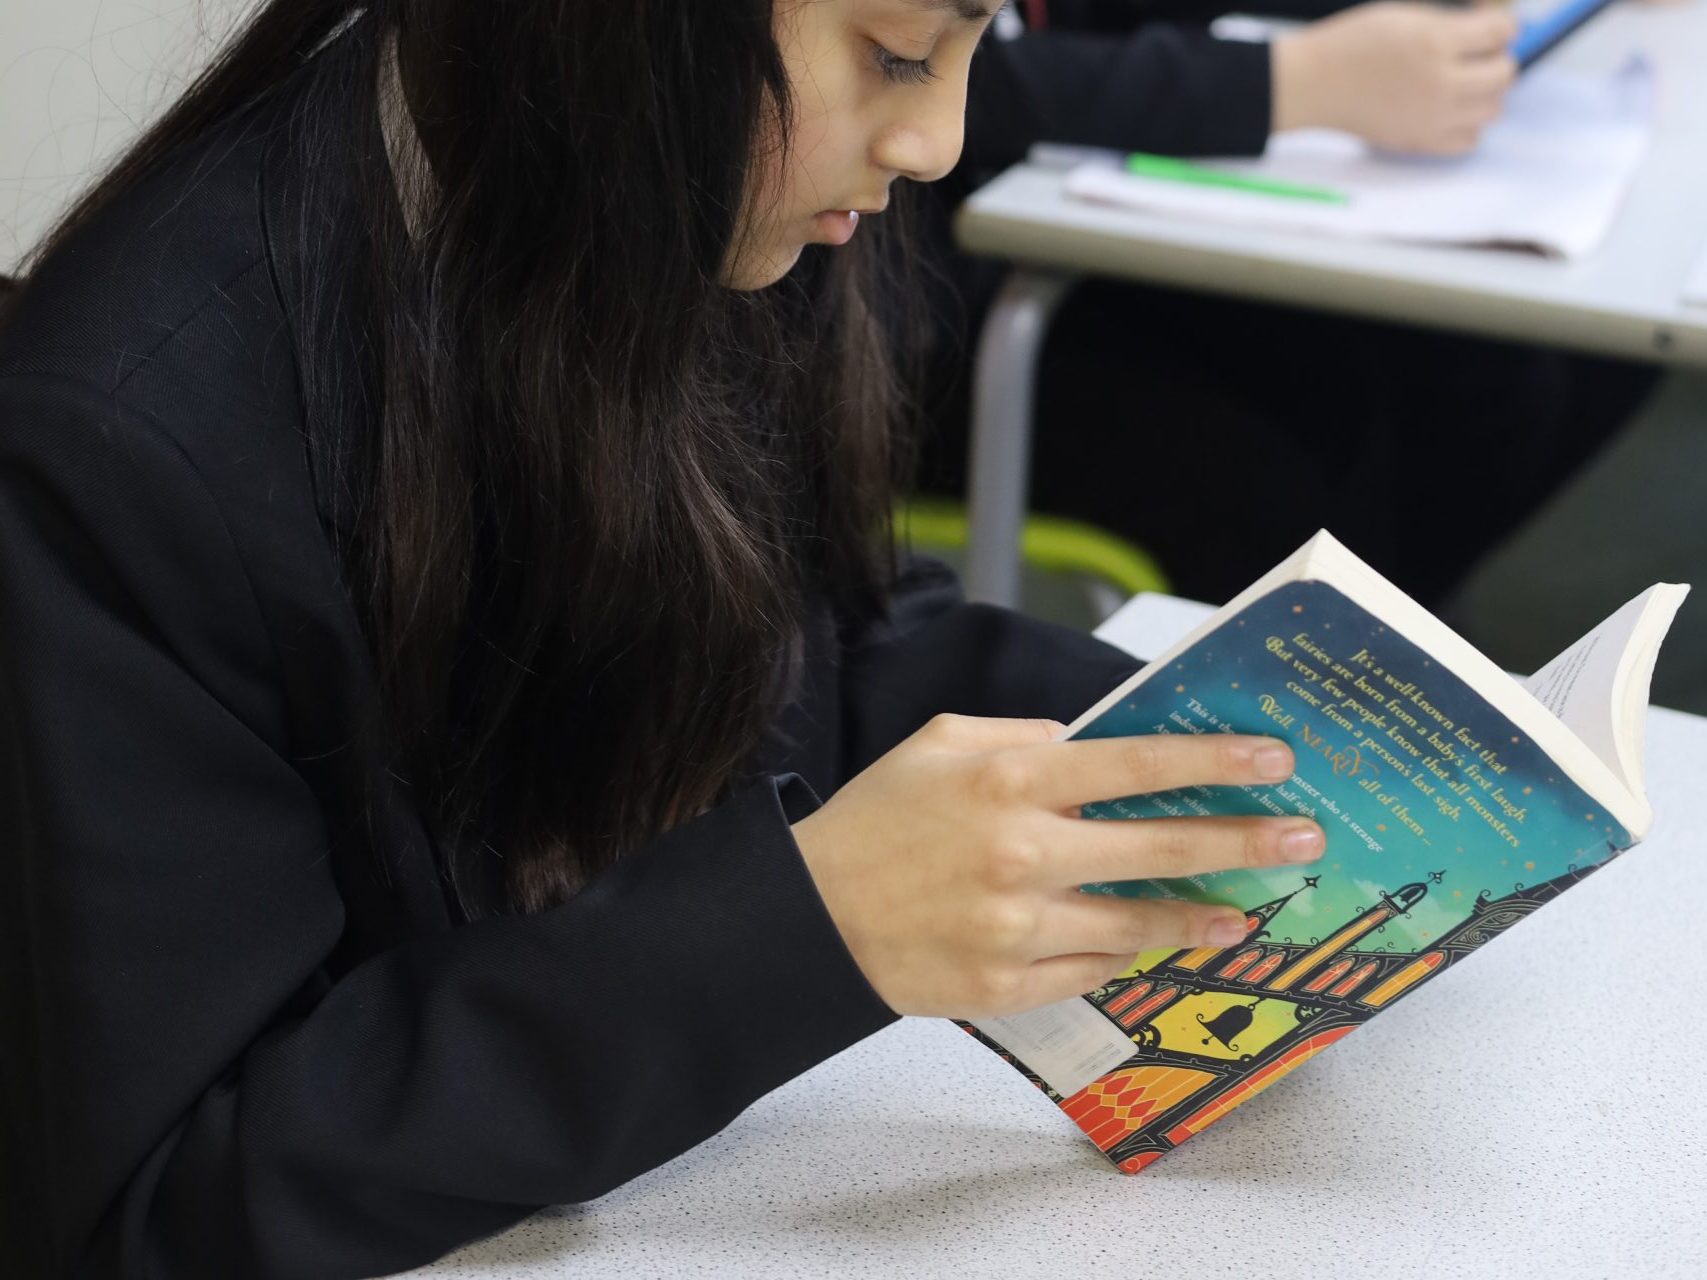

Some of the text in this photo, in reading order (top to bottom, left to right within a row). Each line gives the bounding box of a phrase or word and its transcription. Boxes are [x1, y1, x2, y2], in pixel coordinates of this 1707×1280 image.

[1265, 636, 1520, 848] But very few people know that all monsters
[1286, 681, 1321, 707] come
[1321, 703, 1354, 731] from
[1353, 729, 1364, 738] a
[1359, 738, 1413, 777] person's
[1411, 773, 1436, 796] last
[1292, 632, 1332, 665] fairies
[1331, 663, 1355, 680] are
[1354, 675, 1385, 703] born
[1385, 699, 1417, 728] from
[1416, 726, 1428, 736] a
[1427, 731, 1466, 767] baby's
[1464, 764, 1493, 790] first
[1295, 723, 1380, 779] NEARLY
[1358, 779, 1382, 793] all
[1376, 792, 1399, 805] of
[1349, 648, 1508, 775] It's a well-known fact that
[1183, 795, 1211, 816] whisp
[1185, 697, 1210, 719] This
[1207, 714, 1219, 725] is
[1217, 723, 1235, 735] th
[1320, 795, 1340, 815] who
[1340, 811, 1351, 823] is
[1349, 821, 1384, 852] strange
[1251, 790, 1289, 816] a hum
[1275, 784, 1301, 802] half
